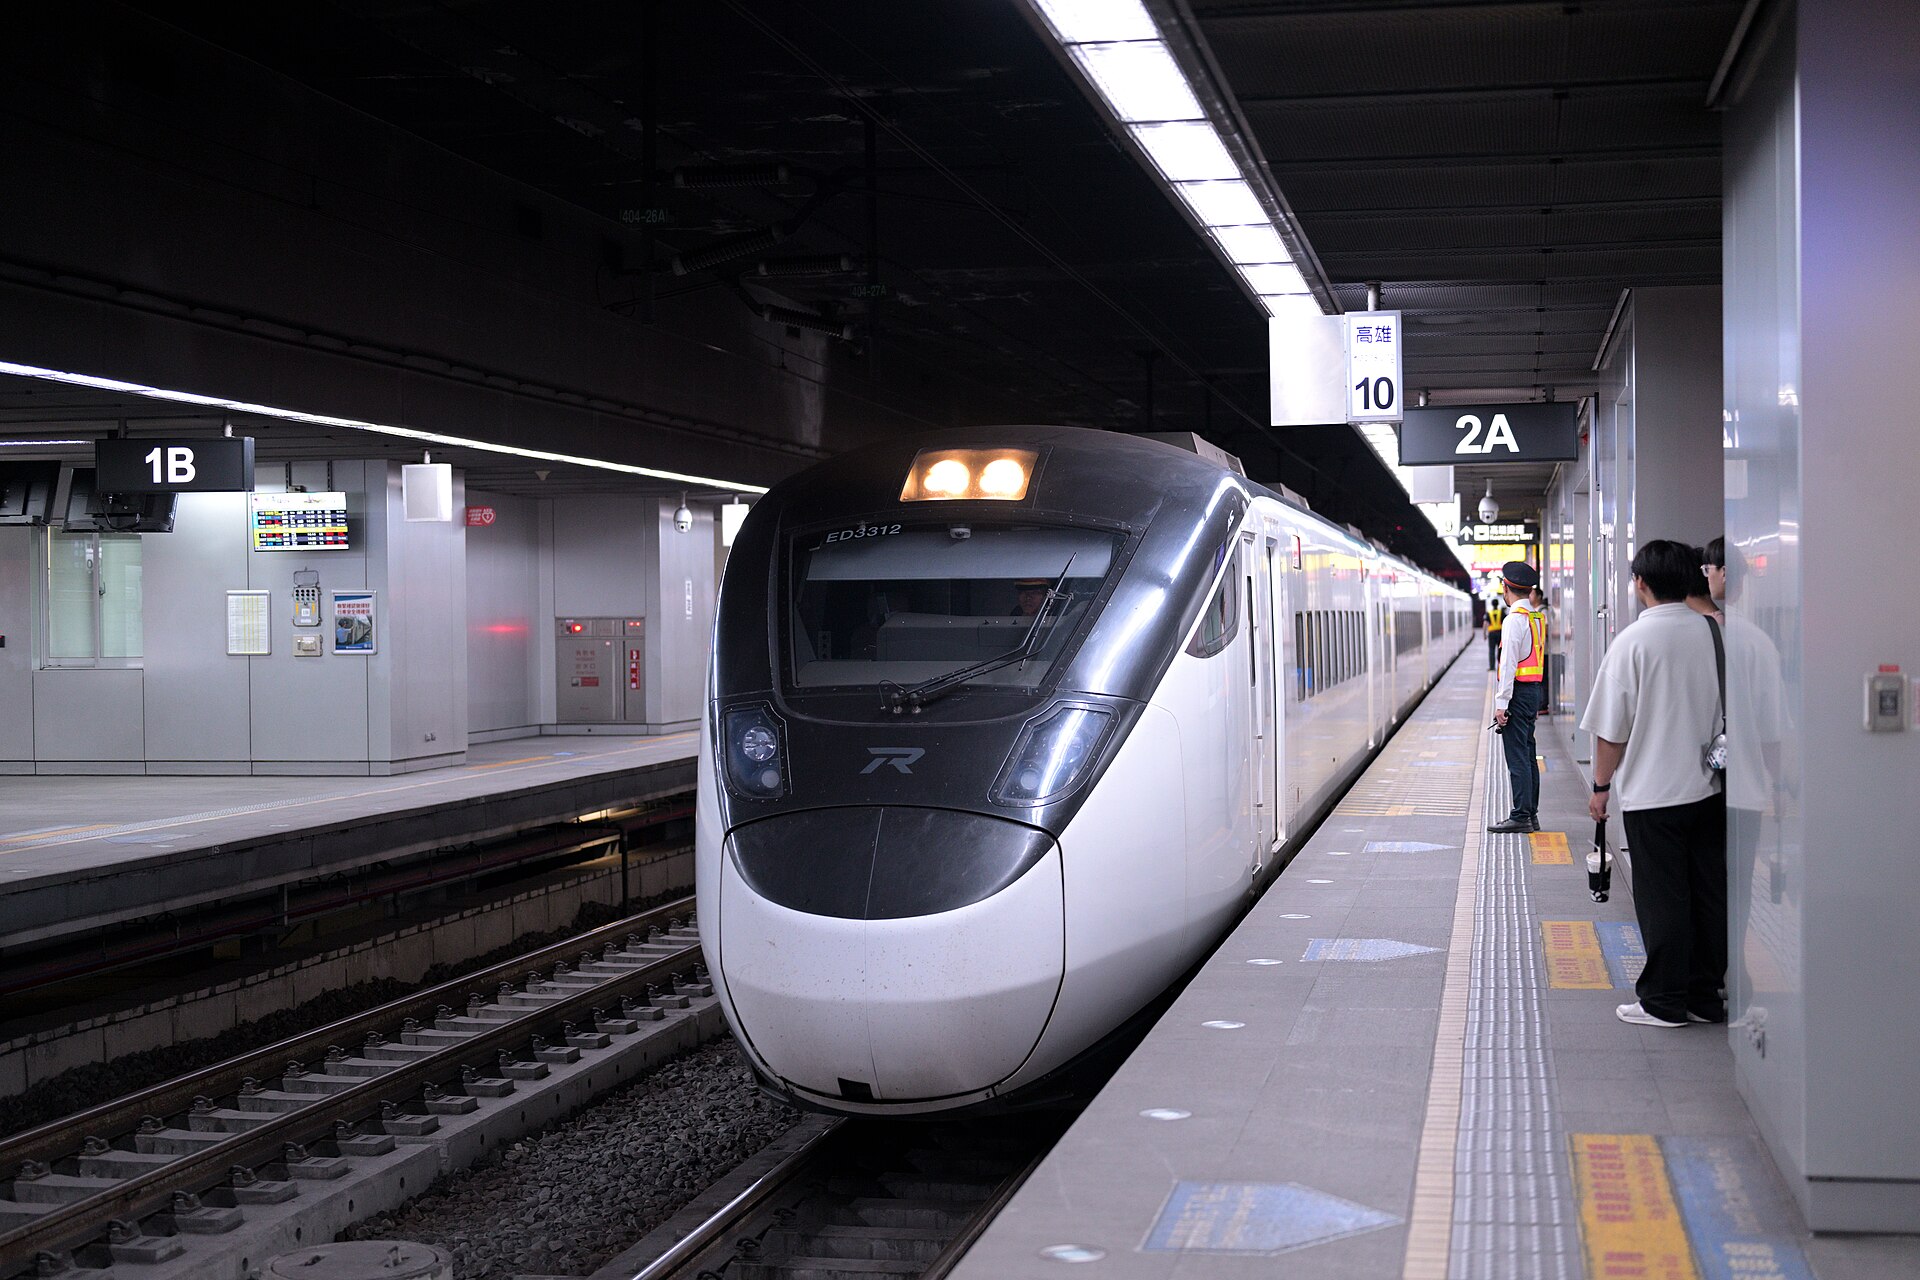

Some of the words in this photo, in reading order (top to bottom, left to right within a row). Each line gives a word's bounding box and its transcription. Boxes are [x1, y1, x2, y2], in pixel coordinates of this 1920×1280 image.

[621, 210, 666, 224] 404-26A
[1356, 325, 1392, 344] 高雄
[1355, 377, 1394, 410] 10
[1455, 414, 1520, 455] 2A
[145, 447, 196, 484] 1B
[826, 524, 902, 543] ED3312
